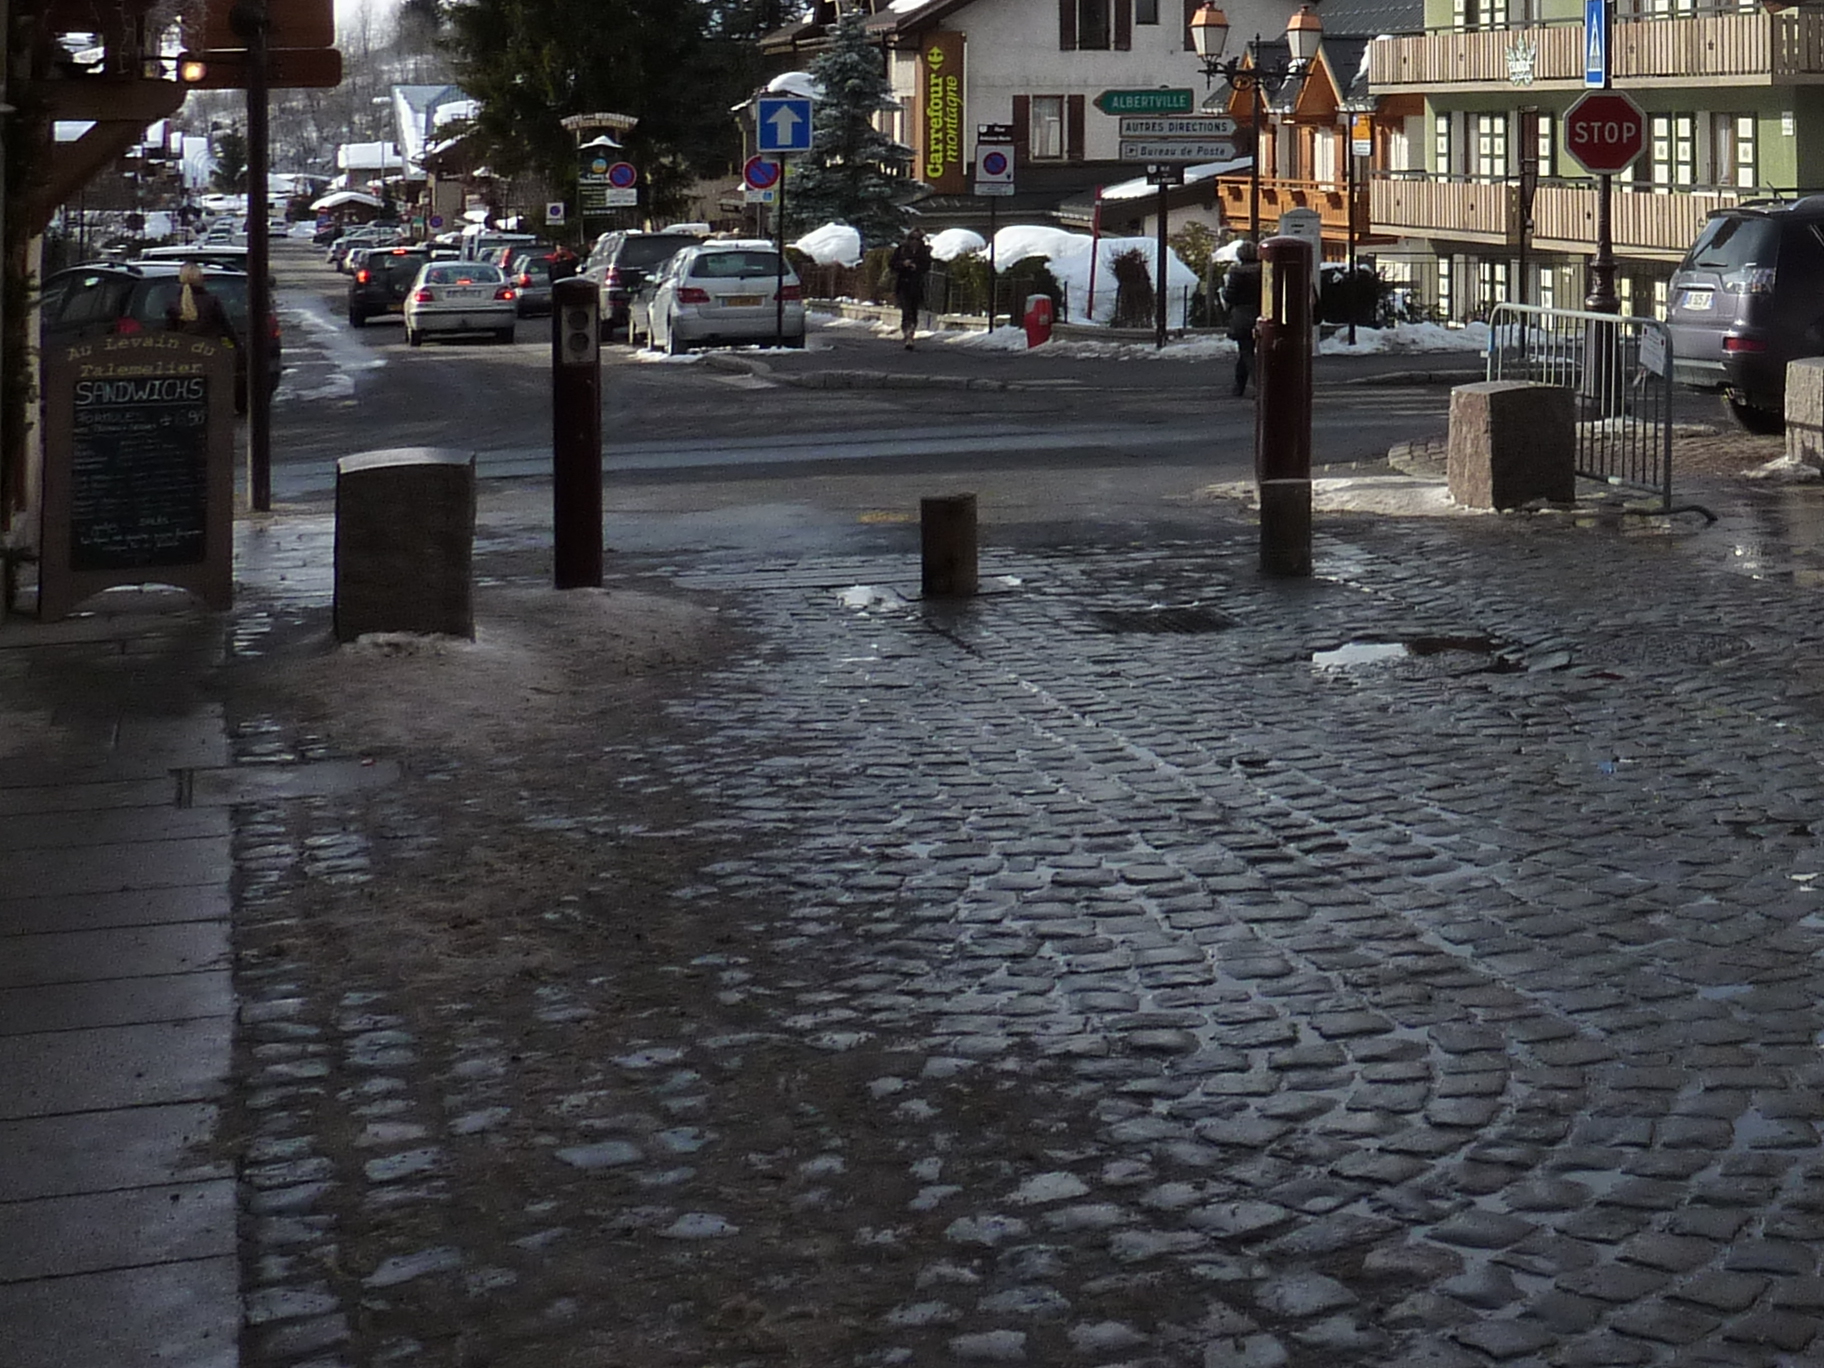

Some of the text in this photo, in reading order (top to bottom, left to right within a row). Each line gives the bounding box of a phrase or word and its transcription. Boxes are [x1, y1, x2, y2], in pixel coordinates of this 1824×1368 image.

[1112, 95, 1186, 109] ALBERTVILLE
[926, 74, 943, 178] Carrefour
[944, 74, 964, 163] montagne
[1125, 122, 1228, 132] AUTRES DIRECTIONS
[1574, 122, 1636, 144] STOP
[1140, 146, 1226, 156] Bureau de Poste
[104, 335, 180, 351] Levain
[191, 342, 216, 356] du
[74, 378, 205, 405] SANDWICHS
